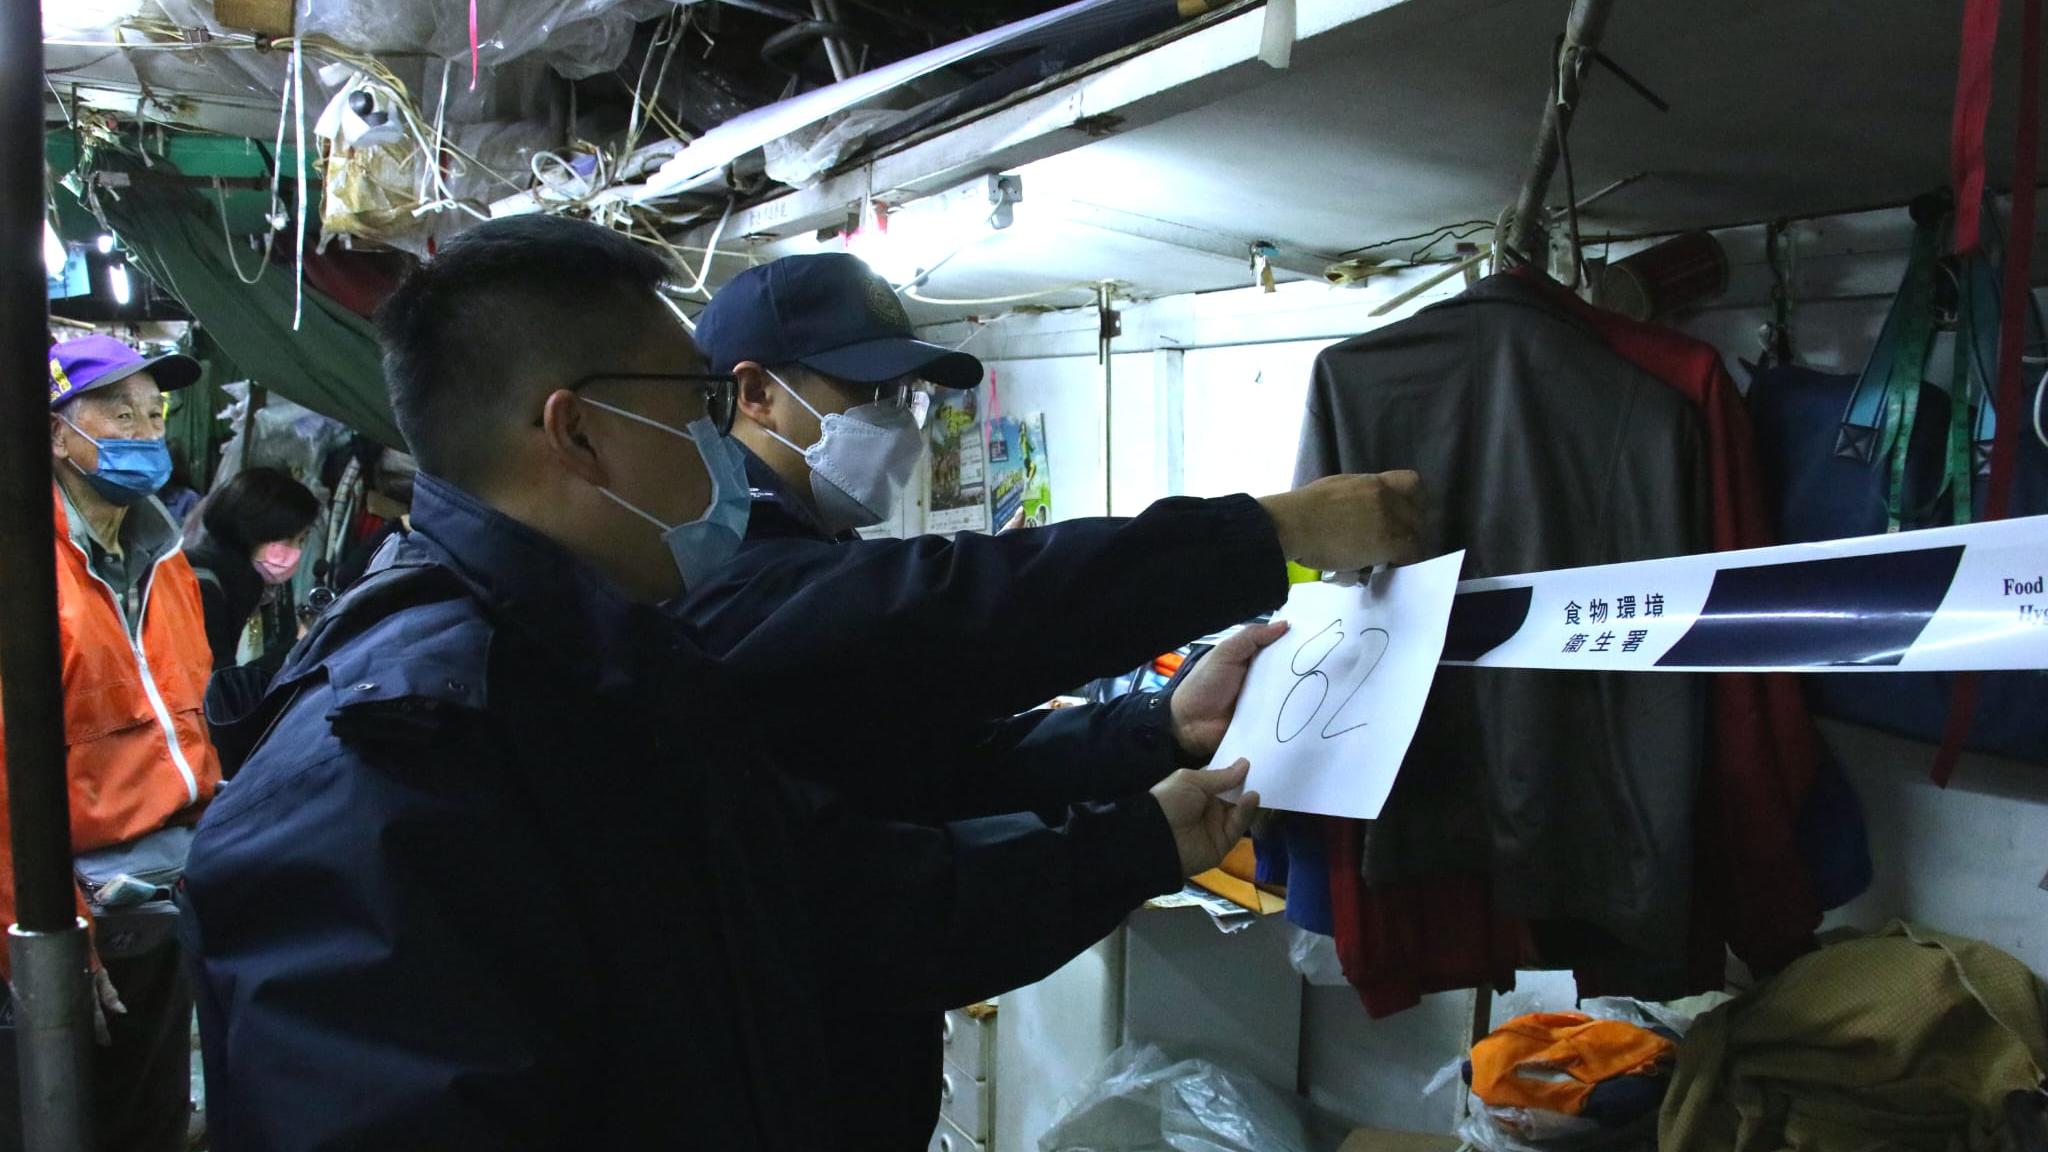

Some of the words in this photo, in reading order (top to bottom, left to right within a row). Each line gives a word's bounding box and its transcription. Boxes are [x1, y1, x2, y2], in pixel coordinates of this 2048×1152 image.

[2003, 575, 2044, 596] Food
[1564, 593, 1664, 626] 食物環境
[1276, 618, 1389, 743] 82
